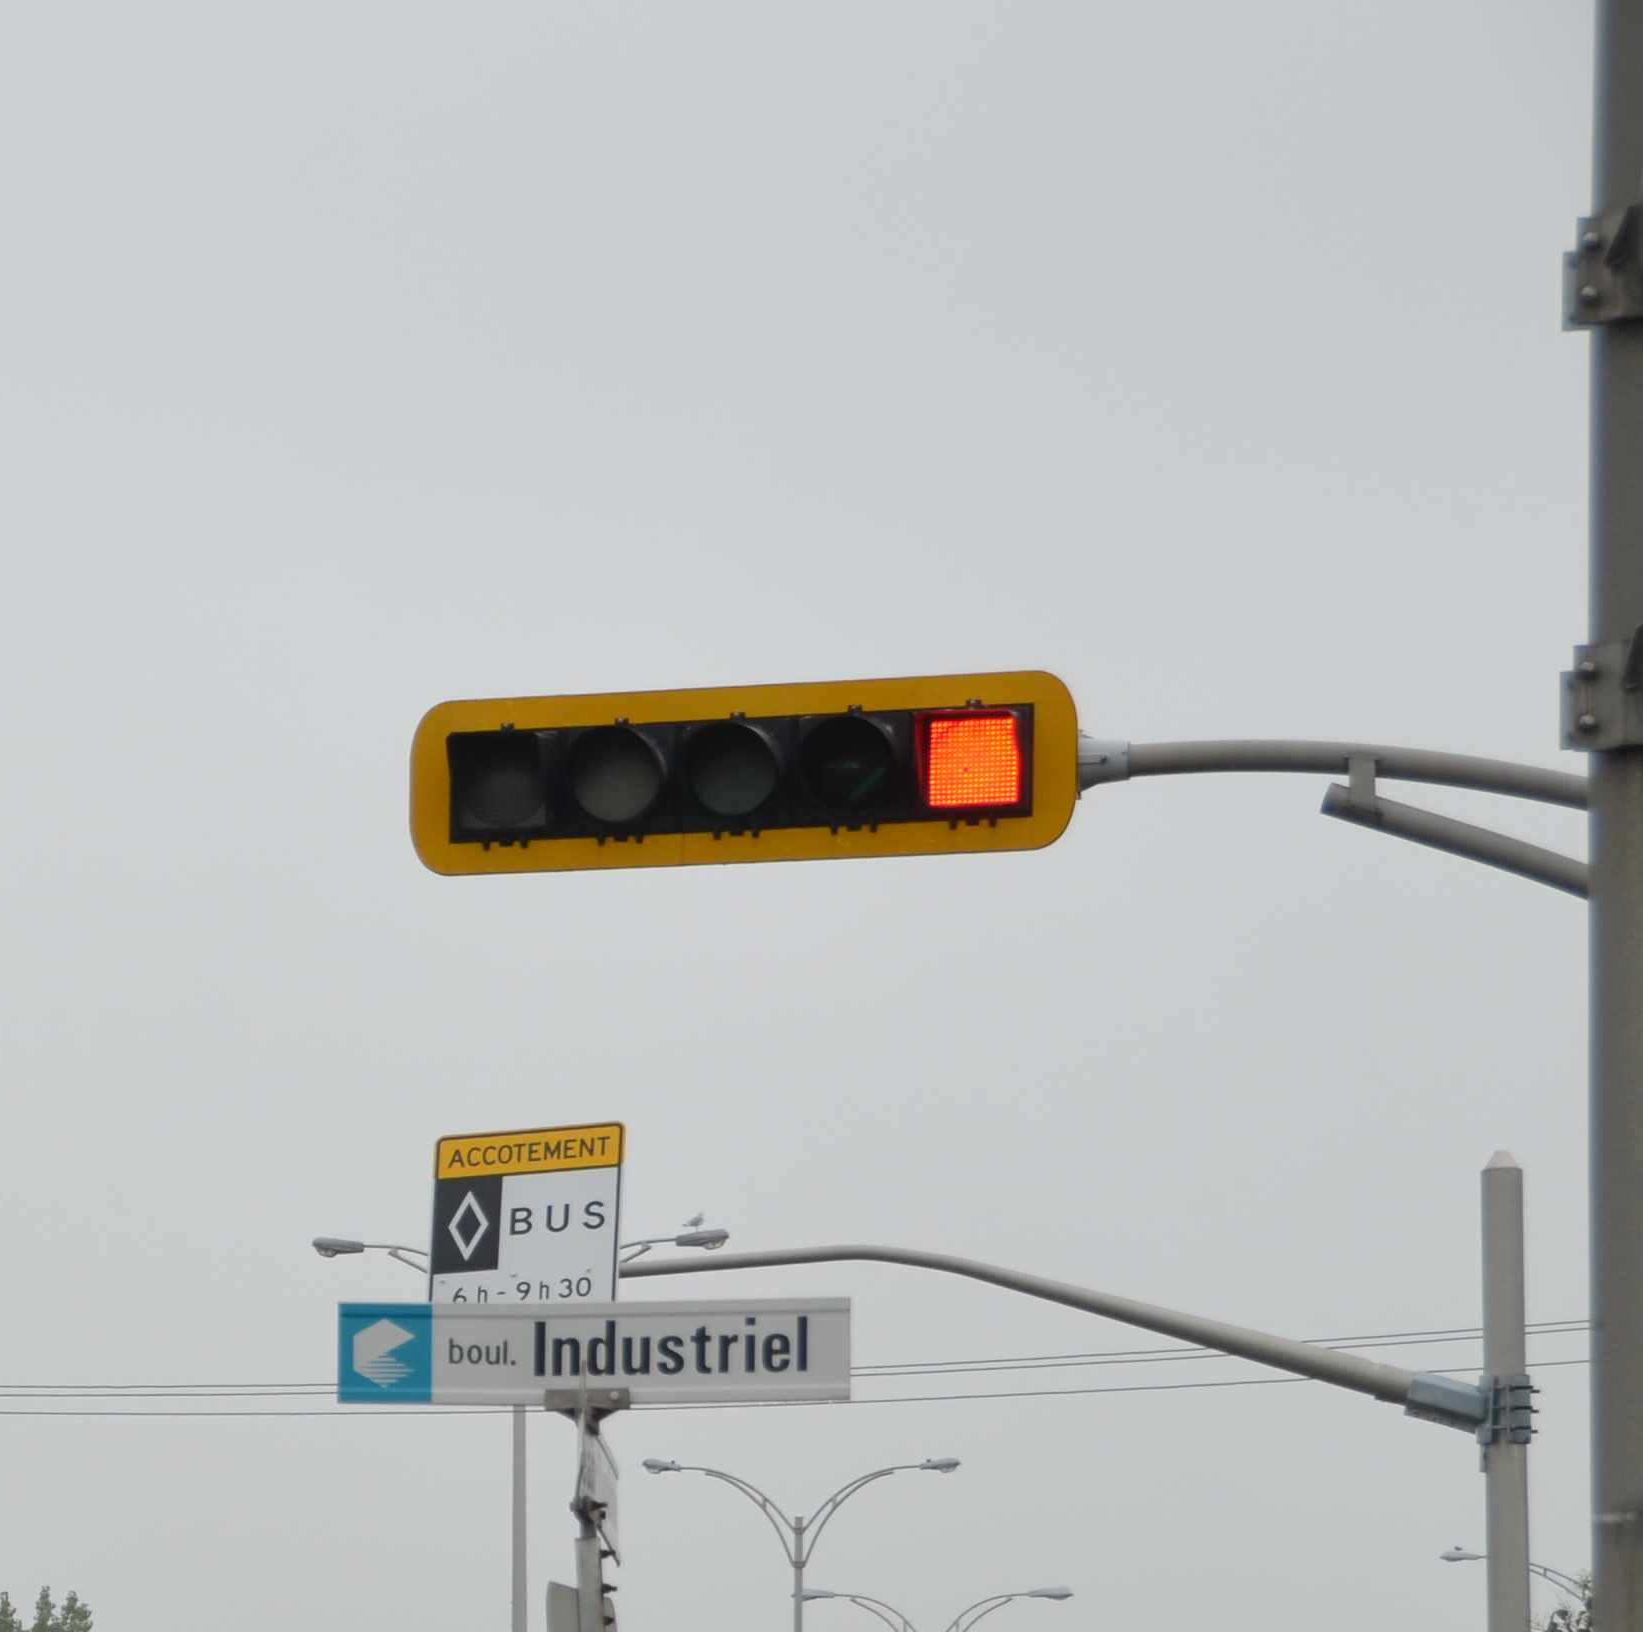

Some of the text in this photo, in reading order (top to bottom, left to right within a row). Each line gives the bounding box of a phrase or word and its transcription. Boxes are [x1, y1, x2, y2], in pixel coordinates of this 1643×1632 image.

[447, 1136, 611, 1169] ACCOTEMENT
[509, 1200, 606, 1236] BUS
[448, 1315, 808, 1377] boul. Industriel
